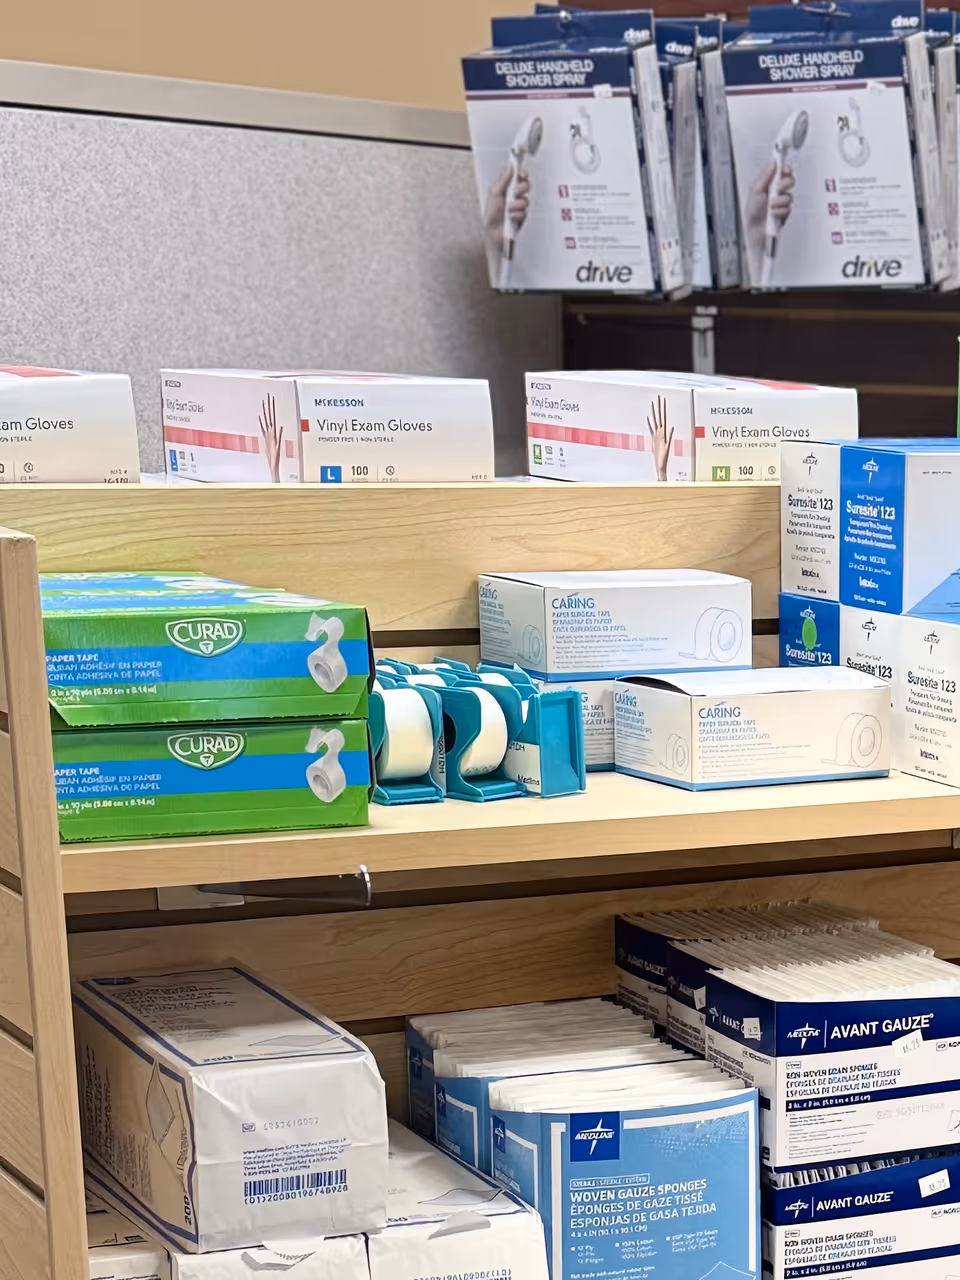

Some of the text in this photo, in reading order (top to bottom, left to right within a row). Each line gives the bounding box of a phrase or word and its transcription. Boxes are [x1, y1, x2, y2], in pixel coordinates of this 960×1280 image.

[495, 60, 594, 74] DELUXE HANDHELD
[759, 50, 863, 68] DELUXE HANDHELD
[770, 64, 856, 80] SHOWER SPRAY
[506, 74, 586, 87] SHOWER SPRAY
[576, 261, 632, 282] drive
[842, 256, 902, 278] drive
[26, 418, 74, 431] Gloves
[317, 419, 432, 434] Vinyl Exam Gloves
[712, 426, 810, 439] Vinyl Exam Gloves
[351, 466, 368, 476] 100
[738, 465, 754, 476] 100
[819, 495, 833, 510] 123
[880, 503, 896, 519] 123
[552, 597, 594, 609] CARING
[173, 623, 237, 642] CURAD
[817, 649, 832, 665] 123
[877, 665, 892, 679] 123
[941, 678, 957, 693] 123
[698, 707, 740, 719] CARING
[175, 736, 237, 755] CURAD
[831, 1015, 931, 1040] AVANT GAUZE
[570, 1179, 707, 1202] WOVEN GAUZE SPONGES
[627, 1201, 639, 1211] DE
[643, 1197, 672, 1208] GAZE
[674, 1191, 703, 1204] TISSÉ
[817, 1192, 891, 1210] AVANT GAUZE
[571, 1203, 716, 1228] ESPONJAS DE GASA TEJIDA
